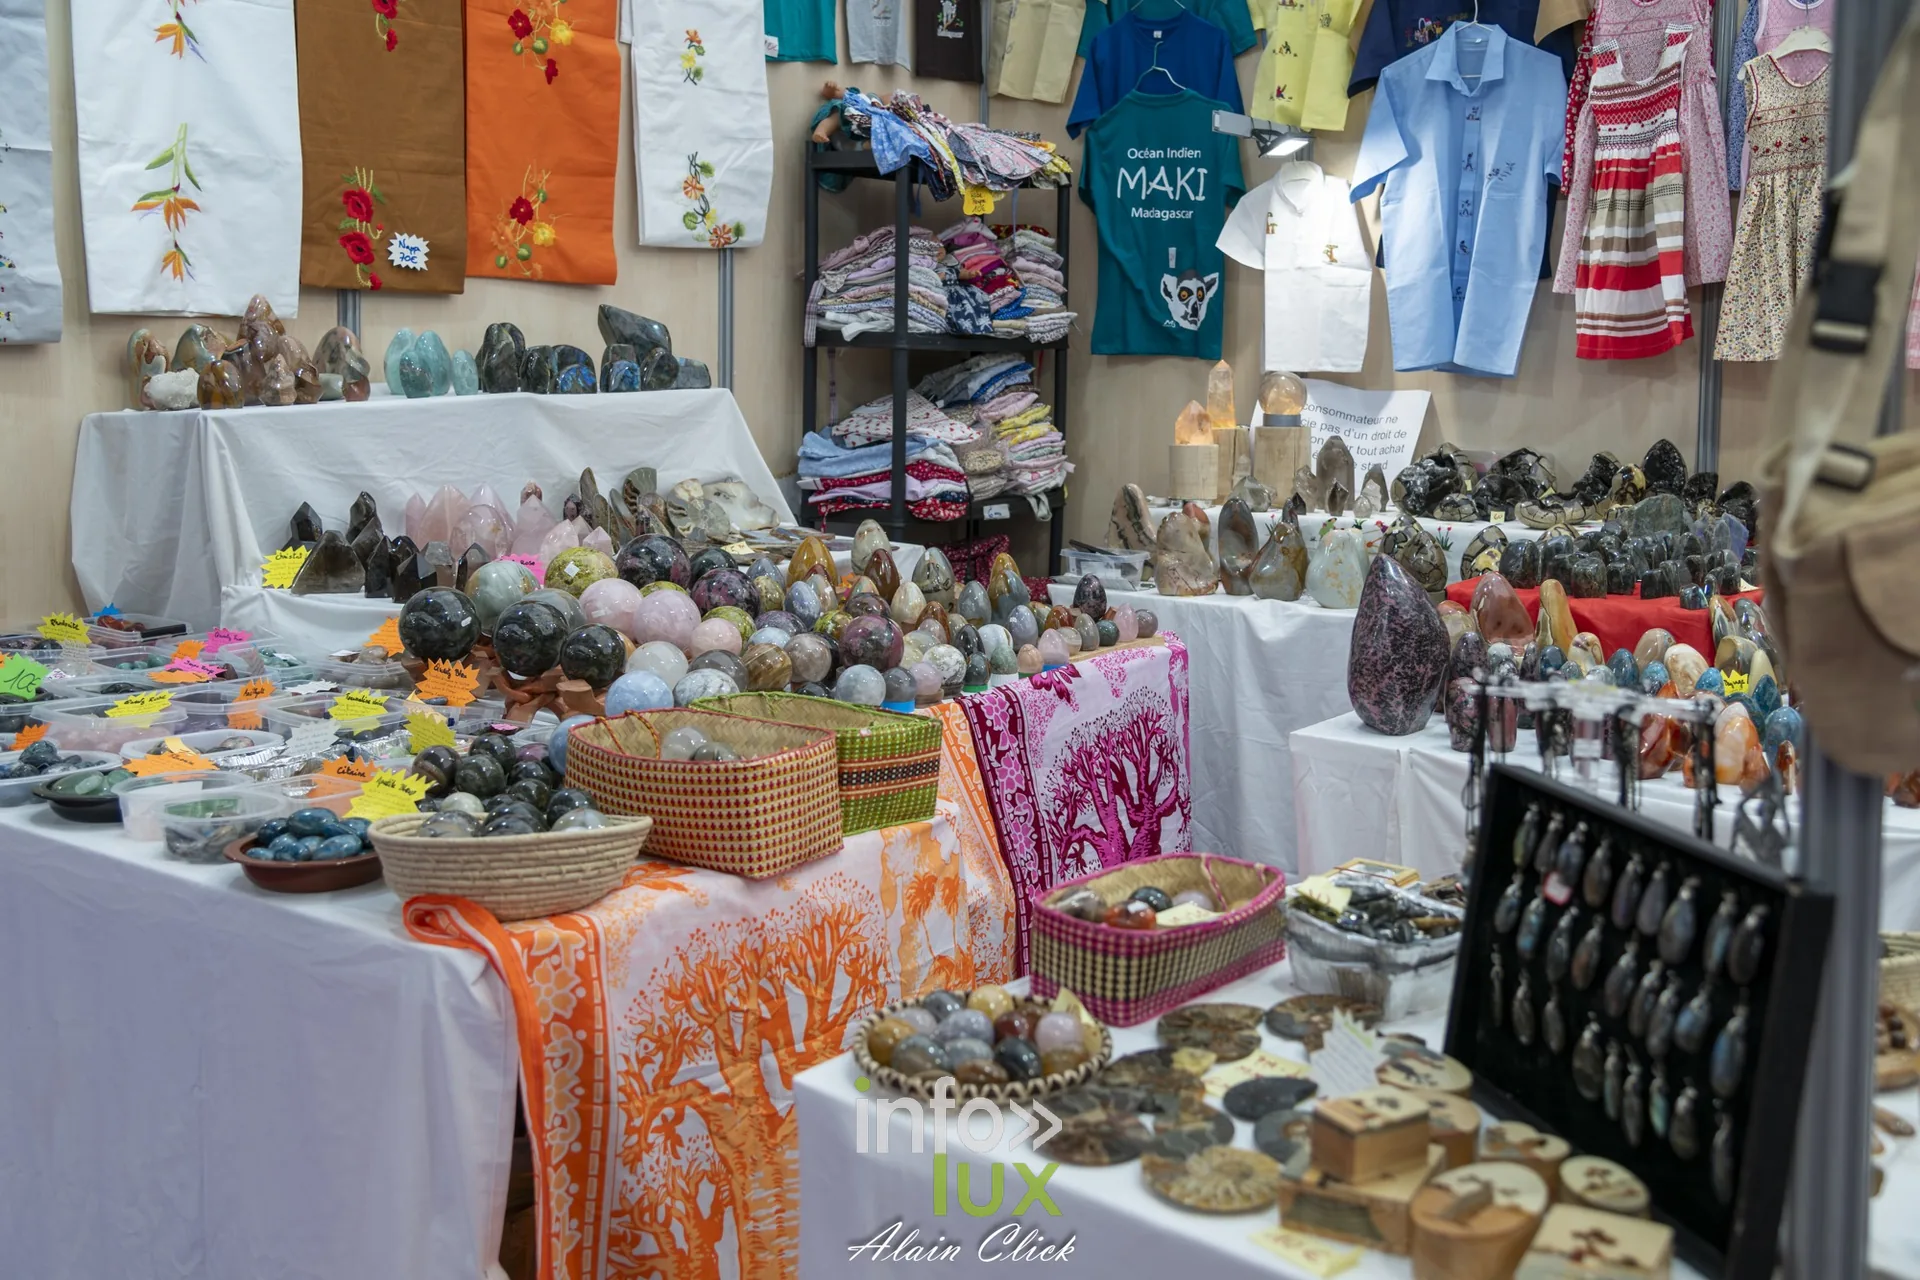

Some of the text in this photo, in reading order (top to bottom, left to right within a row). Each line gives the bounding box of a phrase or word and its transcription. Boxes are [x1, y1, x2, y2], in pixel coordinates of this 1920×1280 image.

[1127, 147, 1201, 159] Océan Indien
[1117, 166, 1208, 201] MAKI
[1131, 207, 1194, 221] Madagascar
[1302, 403, 1383, 425] consommateur
[1385, 416, 1398, 424] ne
[1320, 422, 1341, 434] pas
[1343, 428, 1368, 440] d'un
[1371, 430, 1392, 441] droit
[1393, 429, 1407, 439] de
[1356, 445, 1377, 456] tout
[1379, 444, 1405, 455] achat
